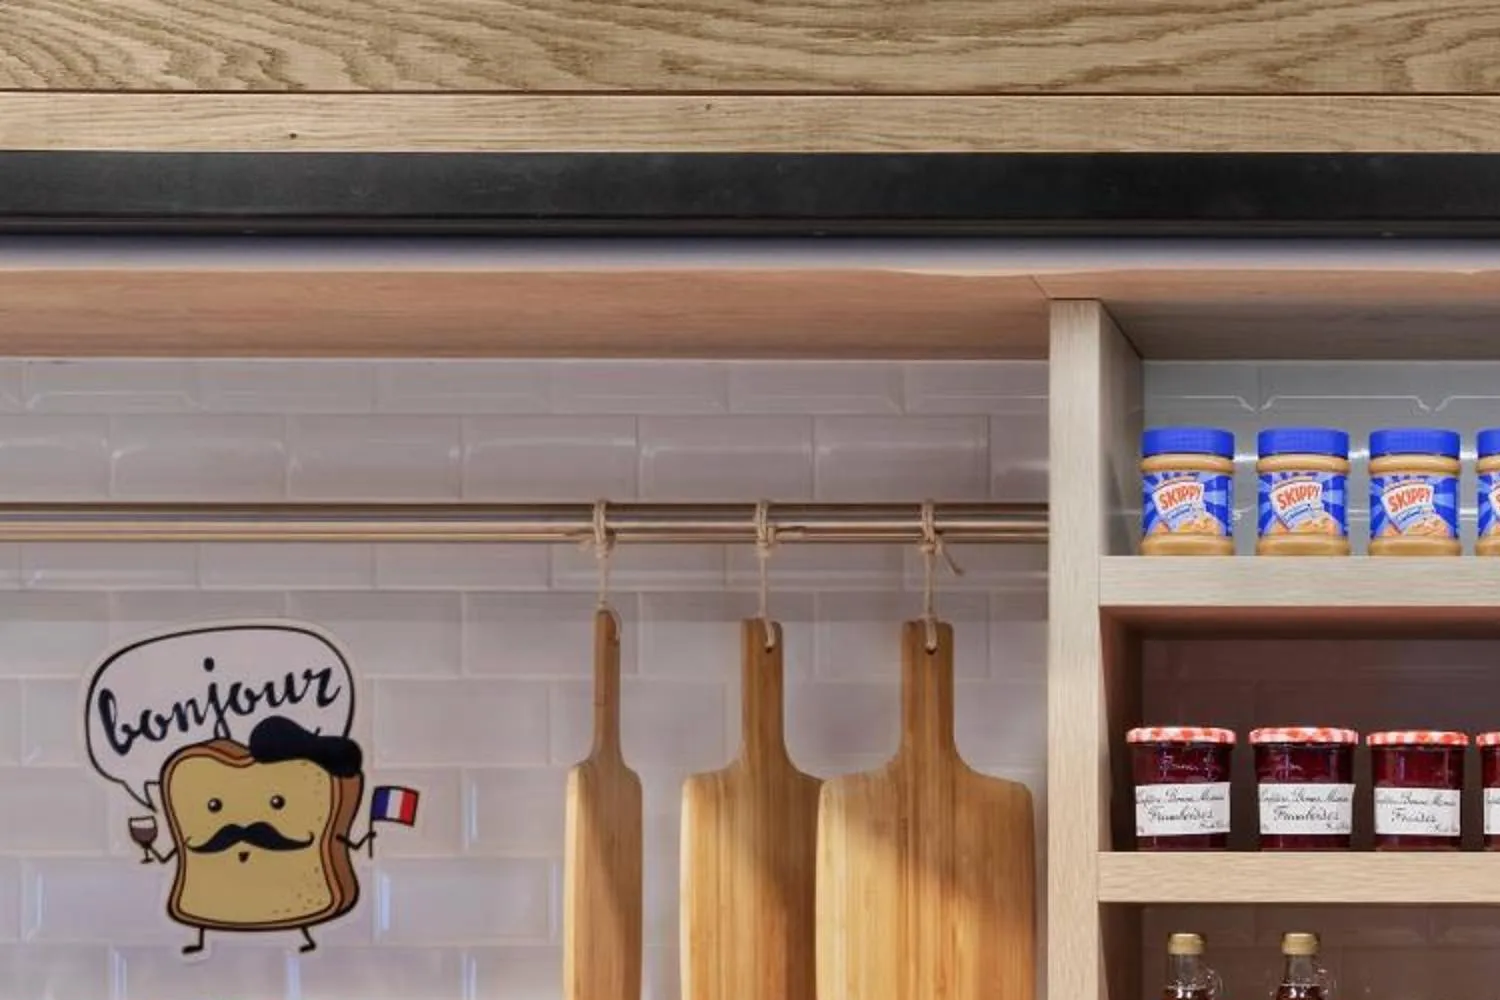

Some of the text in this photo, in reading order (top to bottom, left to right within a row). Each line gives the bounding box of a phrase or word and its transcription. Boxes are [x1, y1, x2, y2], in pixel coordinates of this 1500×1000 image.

[1159, 484, 1201, 510] SKIPPY
[1277, 484, 1321, 511] SKIPPY
[1388, 486, 1432, 512] SKIPPY
[98, 657, 341, 755] bonjour
